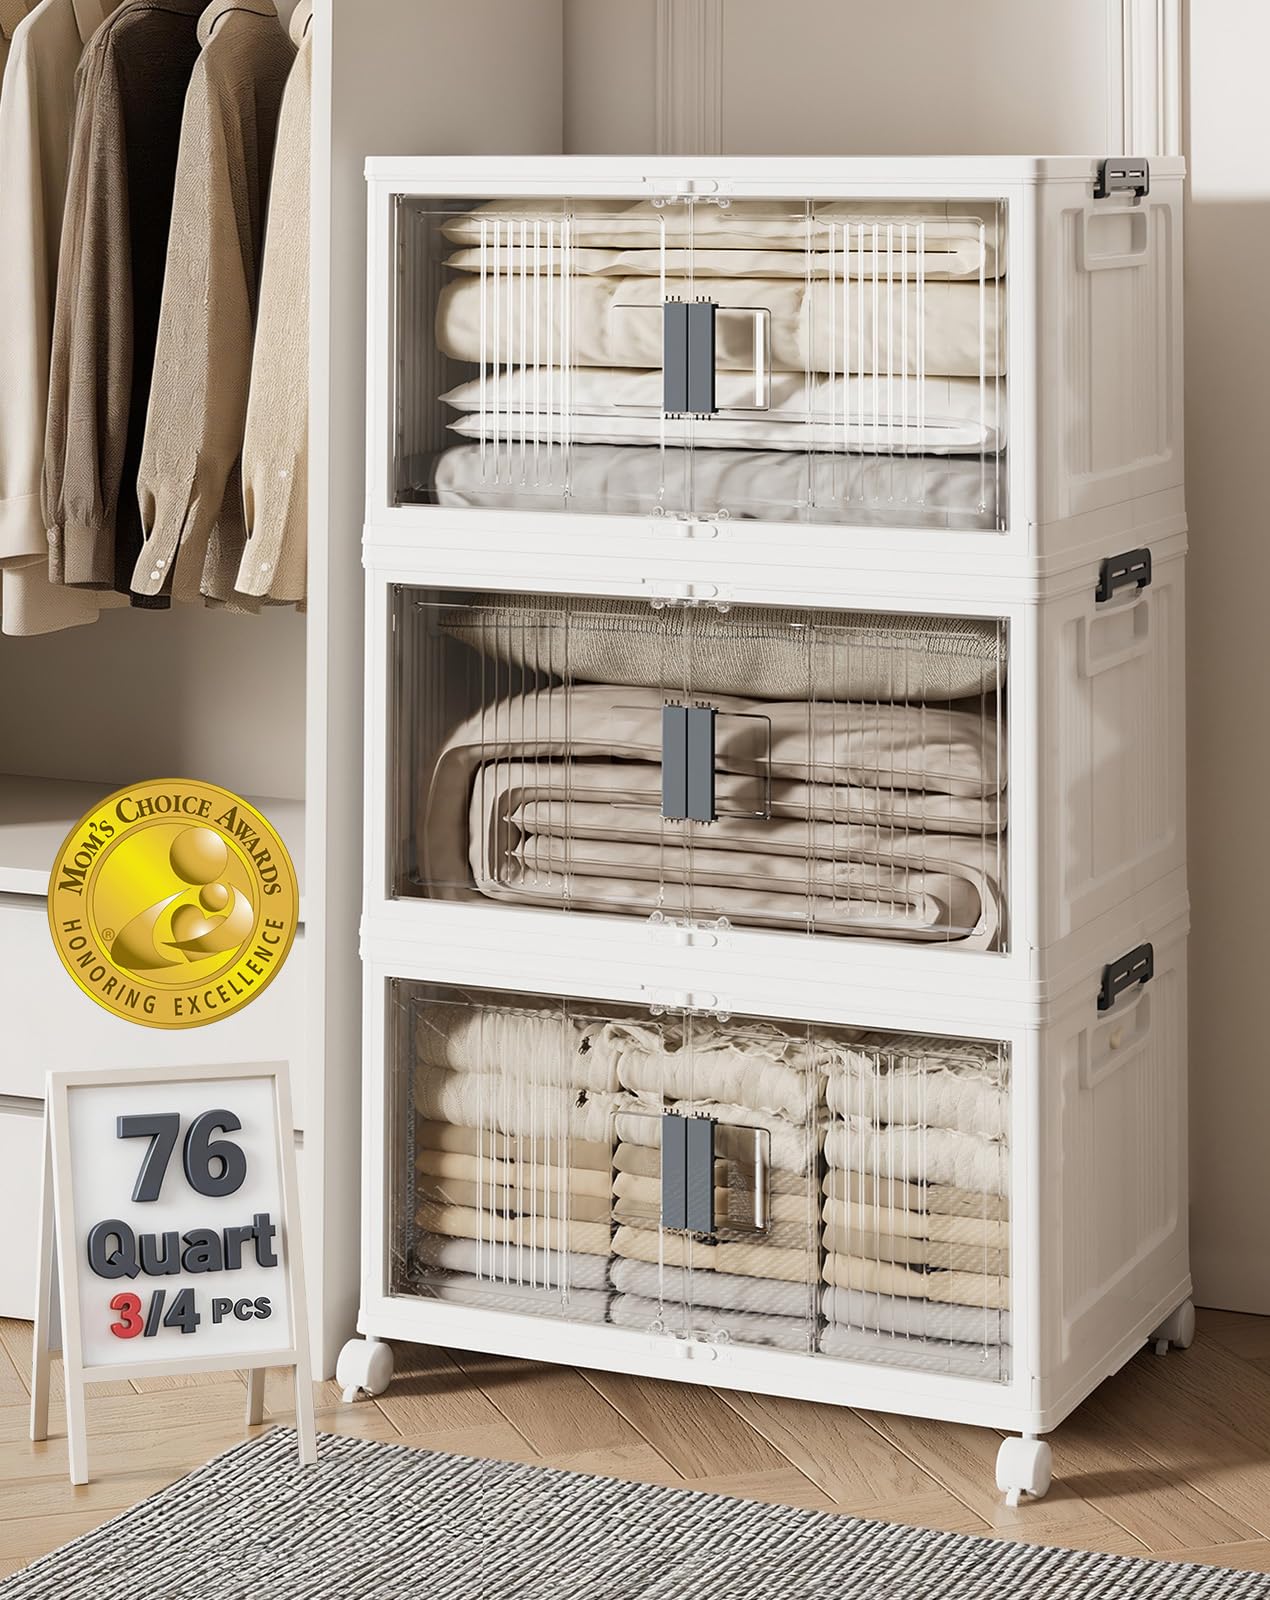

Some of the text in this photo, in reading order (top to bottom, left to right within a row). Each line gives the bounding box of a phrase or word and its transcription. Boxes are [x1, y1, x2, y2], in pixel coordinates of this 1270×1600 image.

[116, 1109, 247, 1202] 76
[87, 1213, 278, 1280] Quart
[110, 1288, 272, 1339] 3/4 PCS
